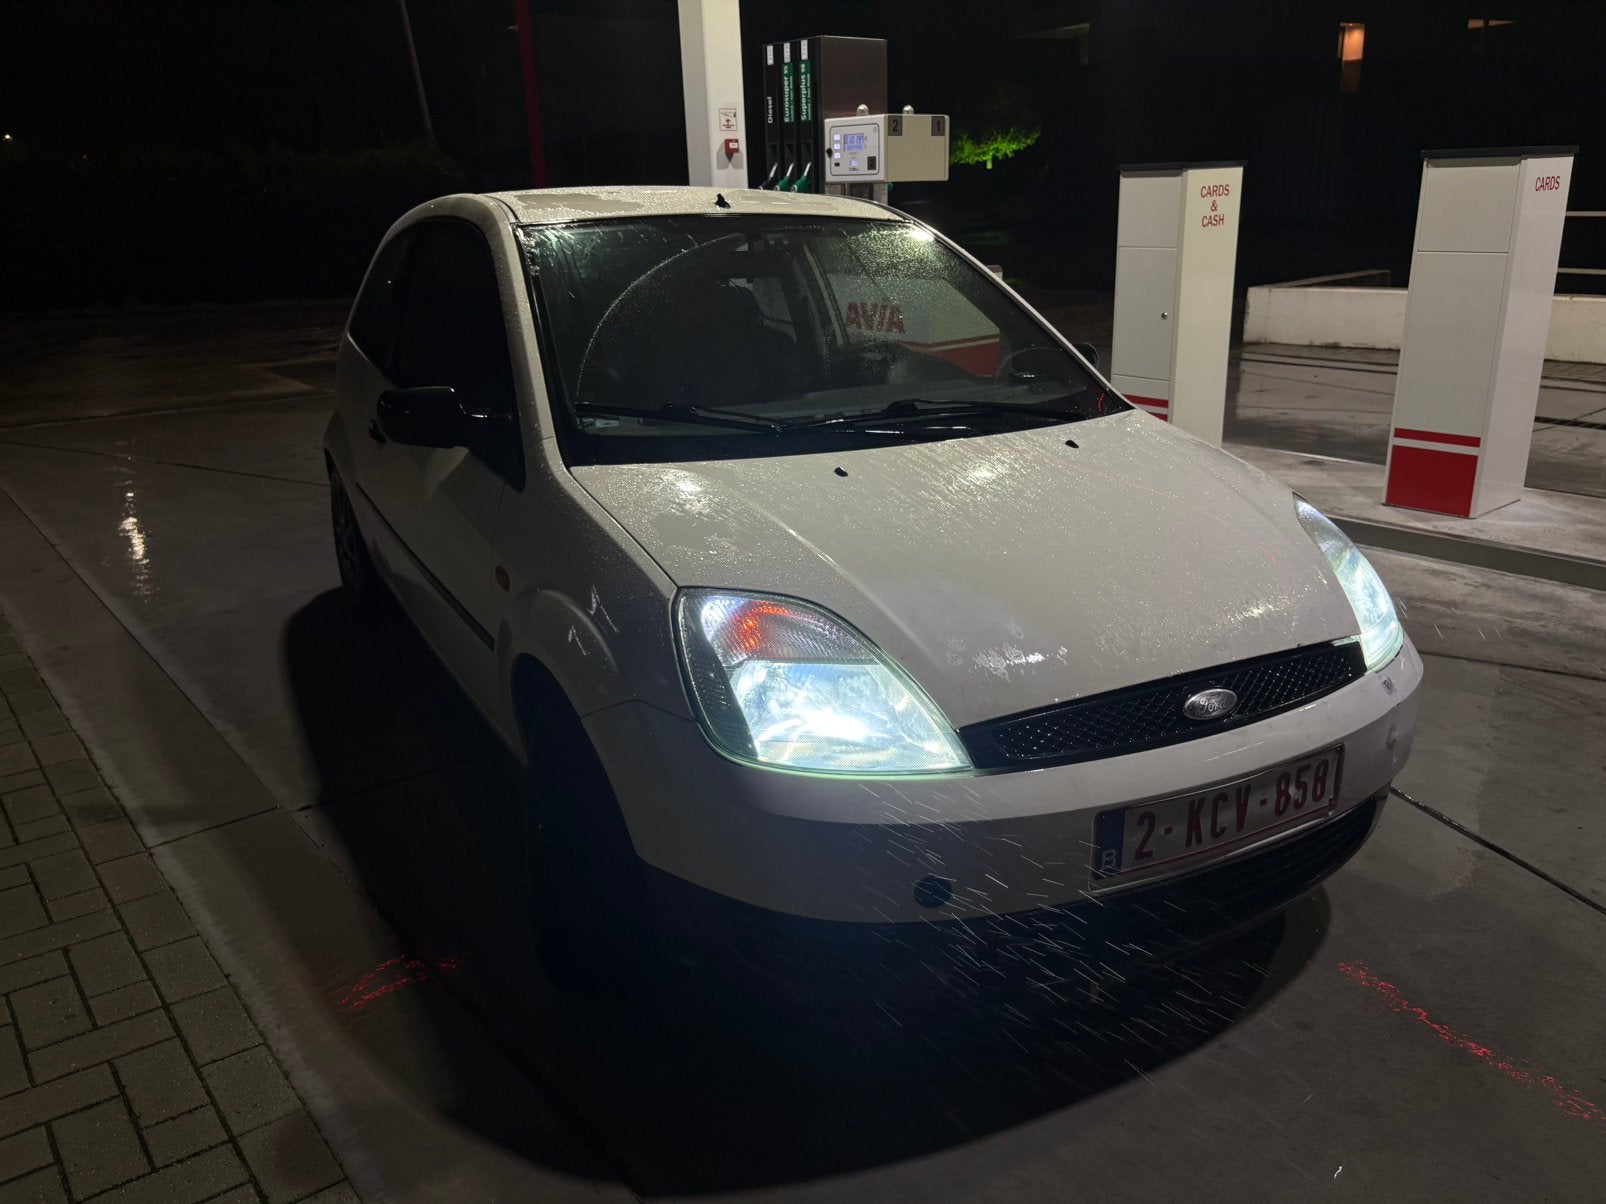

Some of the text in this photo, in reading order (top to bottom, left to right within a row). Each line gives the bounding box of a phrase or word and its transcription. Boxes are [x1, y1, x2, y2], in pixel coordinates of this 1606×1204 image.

[800, 74, 808, 121] Superplus
[766, 96, 774, 124] Diesel
[892, 119, 899, 133] 2
[1200, 184, 1230, 198] CARDS
[1535, 175, 1561, 192] CARDS
[1210, 199, 1218, 212] &
[1202, 213, 1225, 228] CASH
[845, 301, 905, 334] AVIA
[1101, 848, 1118, 870] B
